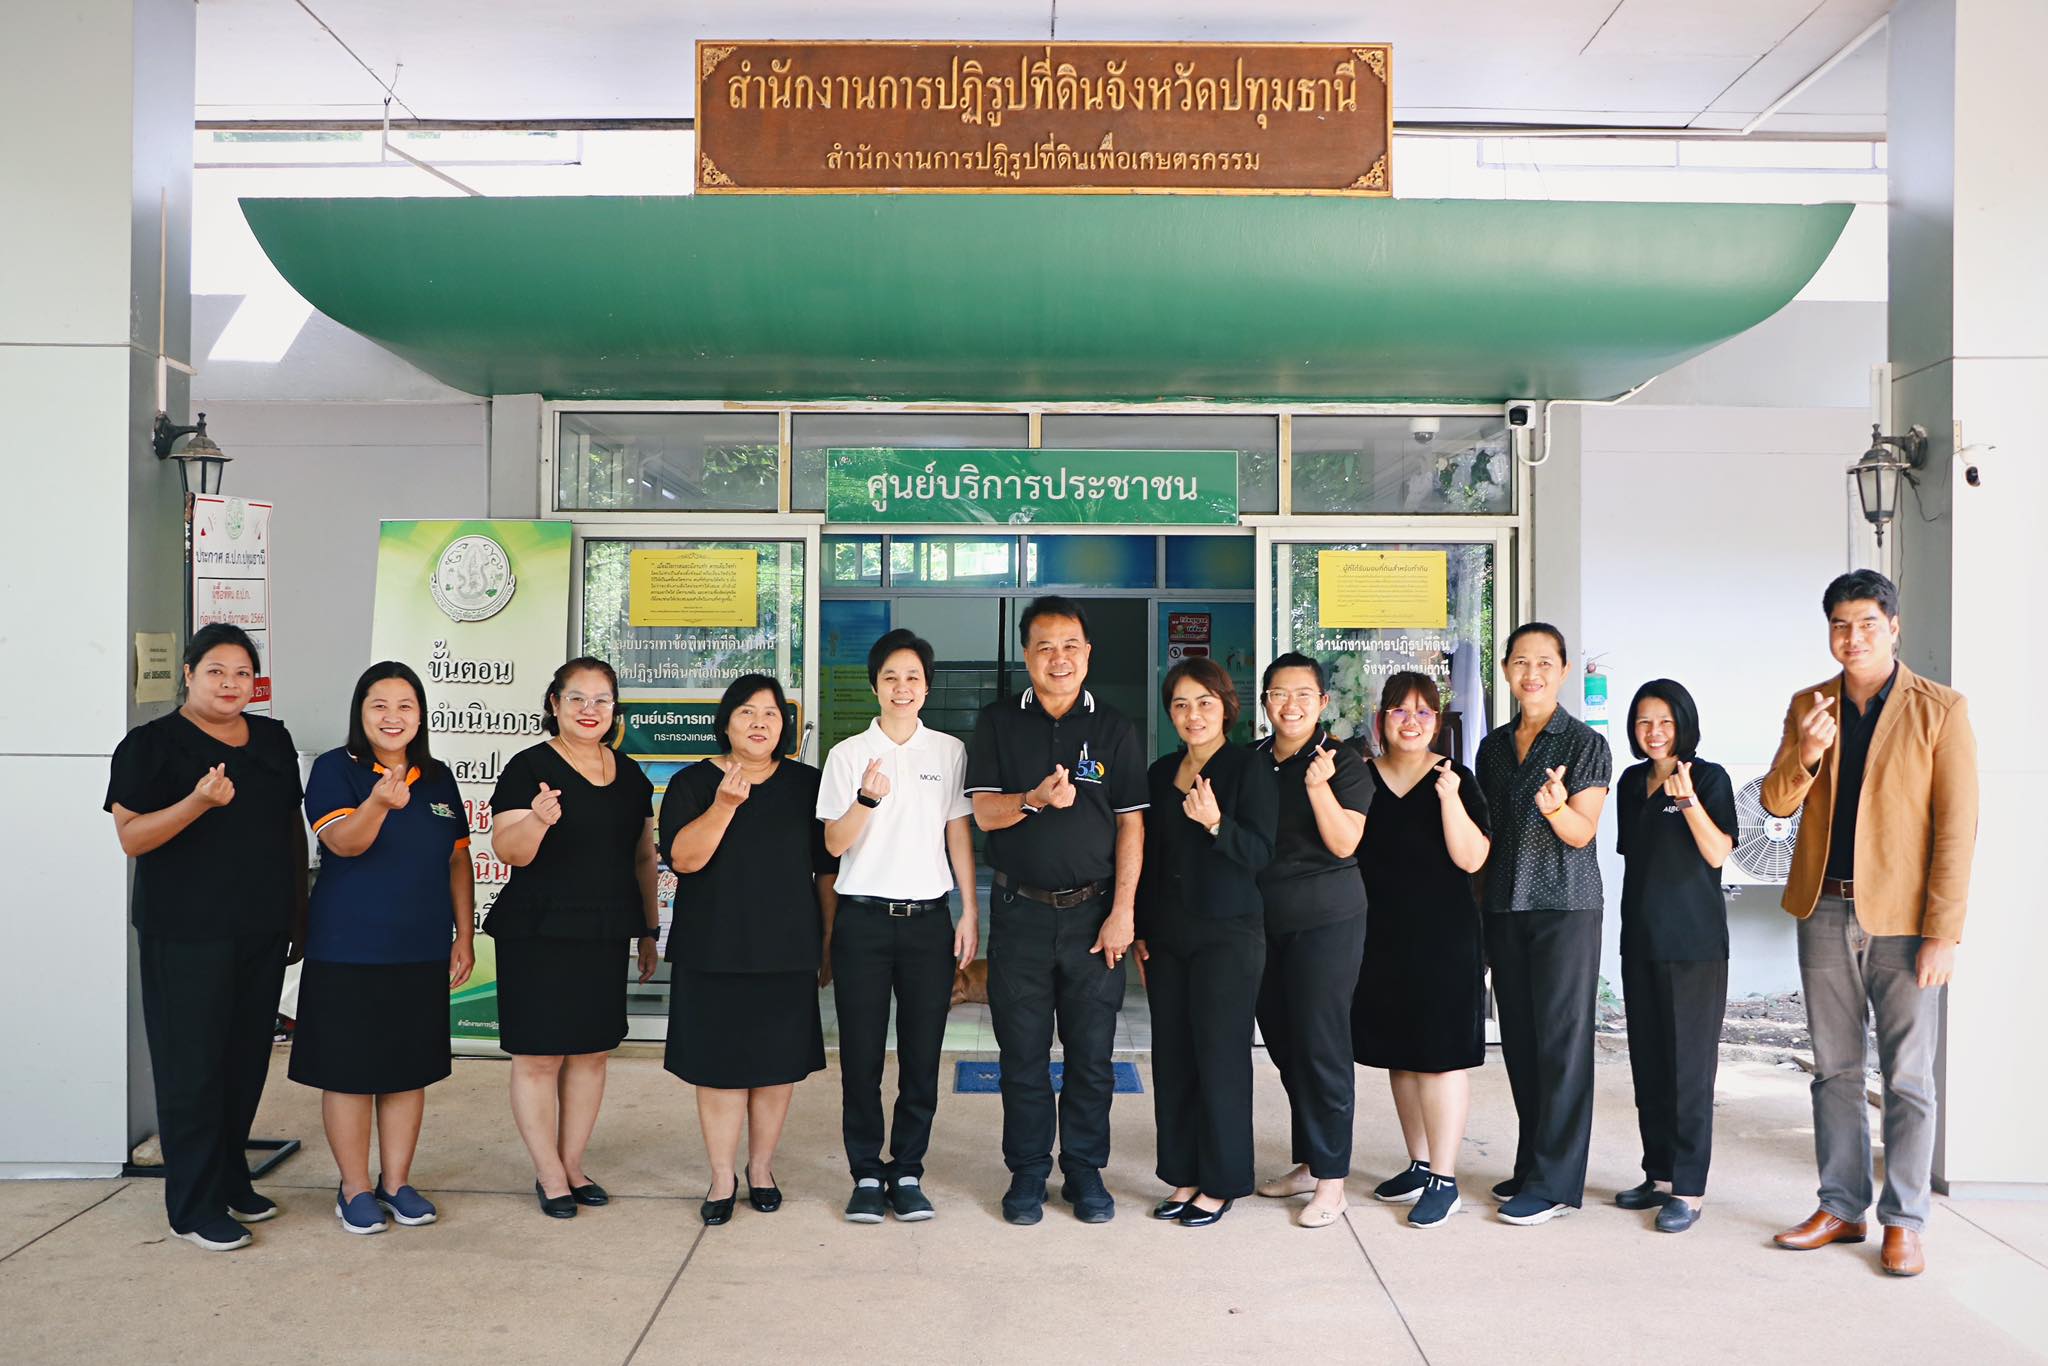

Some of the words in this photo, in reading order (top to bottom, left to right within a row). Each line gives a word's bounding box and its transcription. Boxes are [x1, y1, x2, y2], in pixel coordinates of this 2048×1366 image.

[727, 46, 1357, 130] สำนักงานการปฏิรูปที่ดินจังหวัดปทุมธานี
[826, 133, 1260, 178] สำนักงานการปฏิรูปที่ดินเพื่อเกษตรกรรม
[867, 461, 1198, 512] ศูนย์บริการประชาชน
[428, 641, 511, 681] ขั้นตอน
[1363, 659, 1450, 675] จังหวัดปทมธานี
[431, 702, 542, 731] ดำเนินการ
